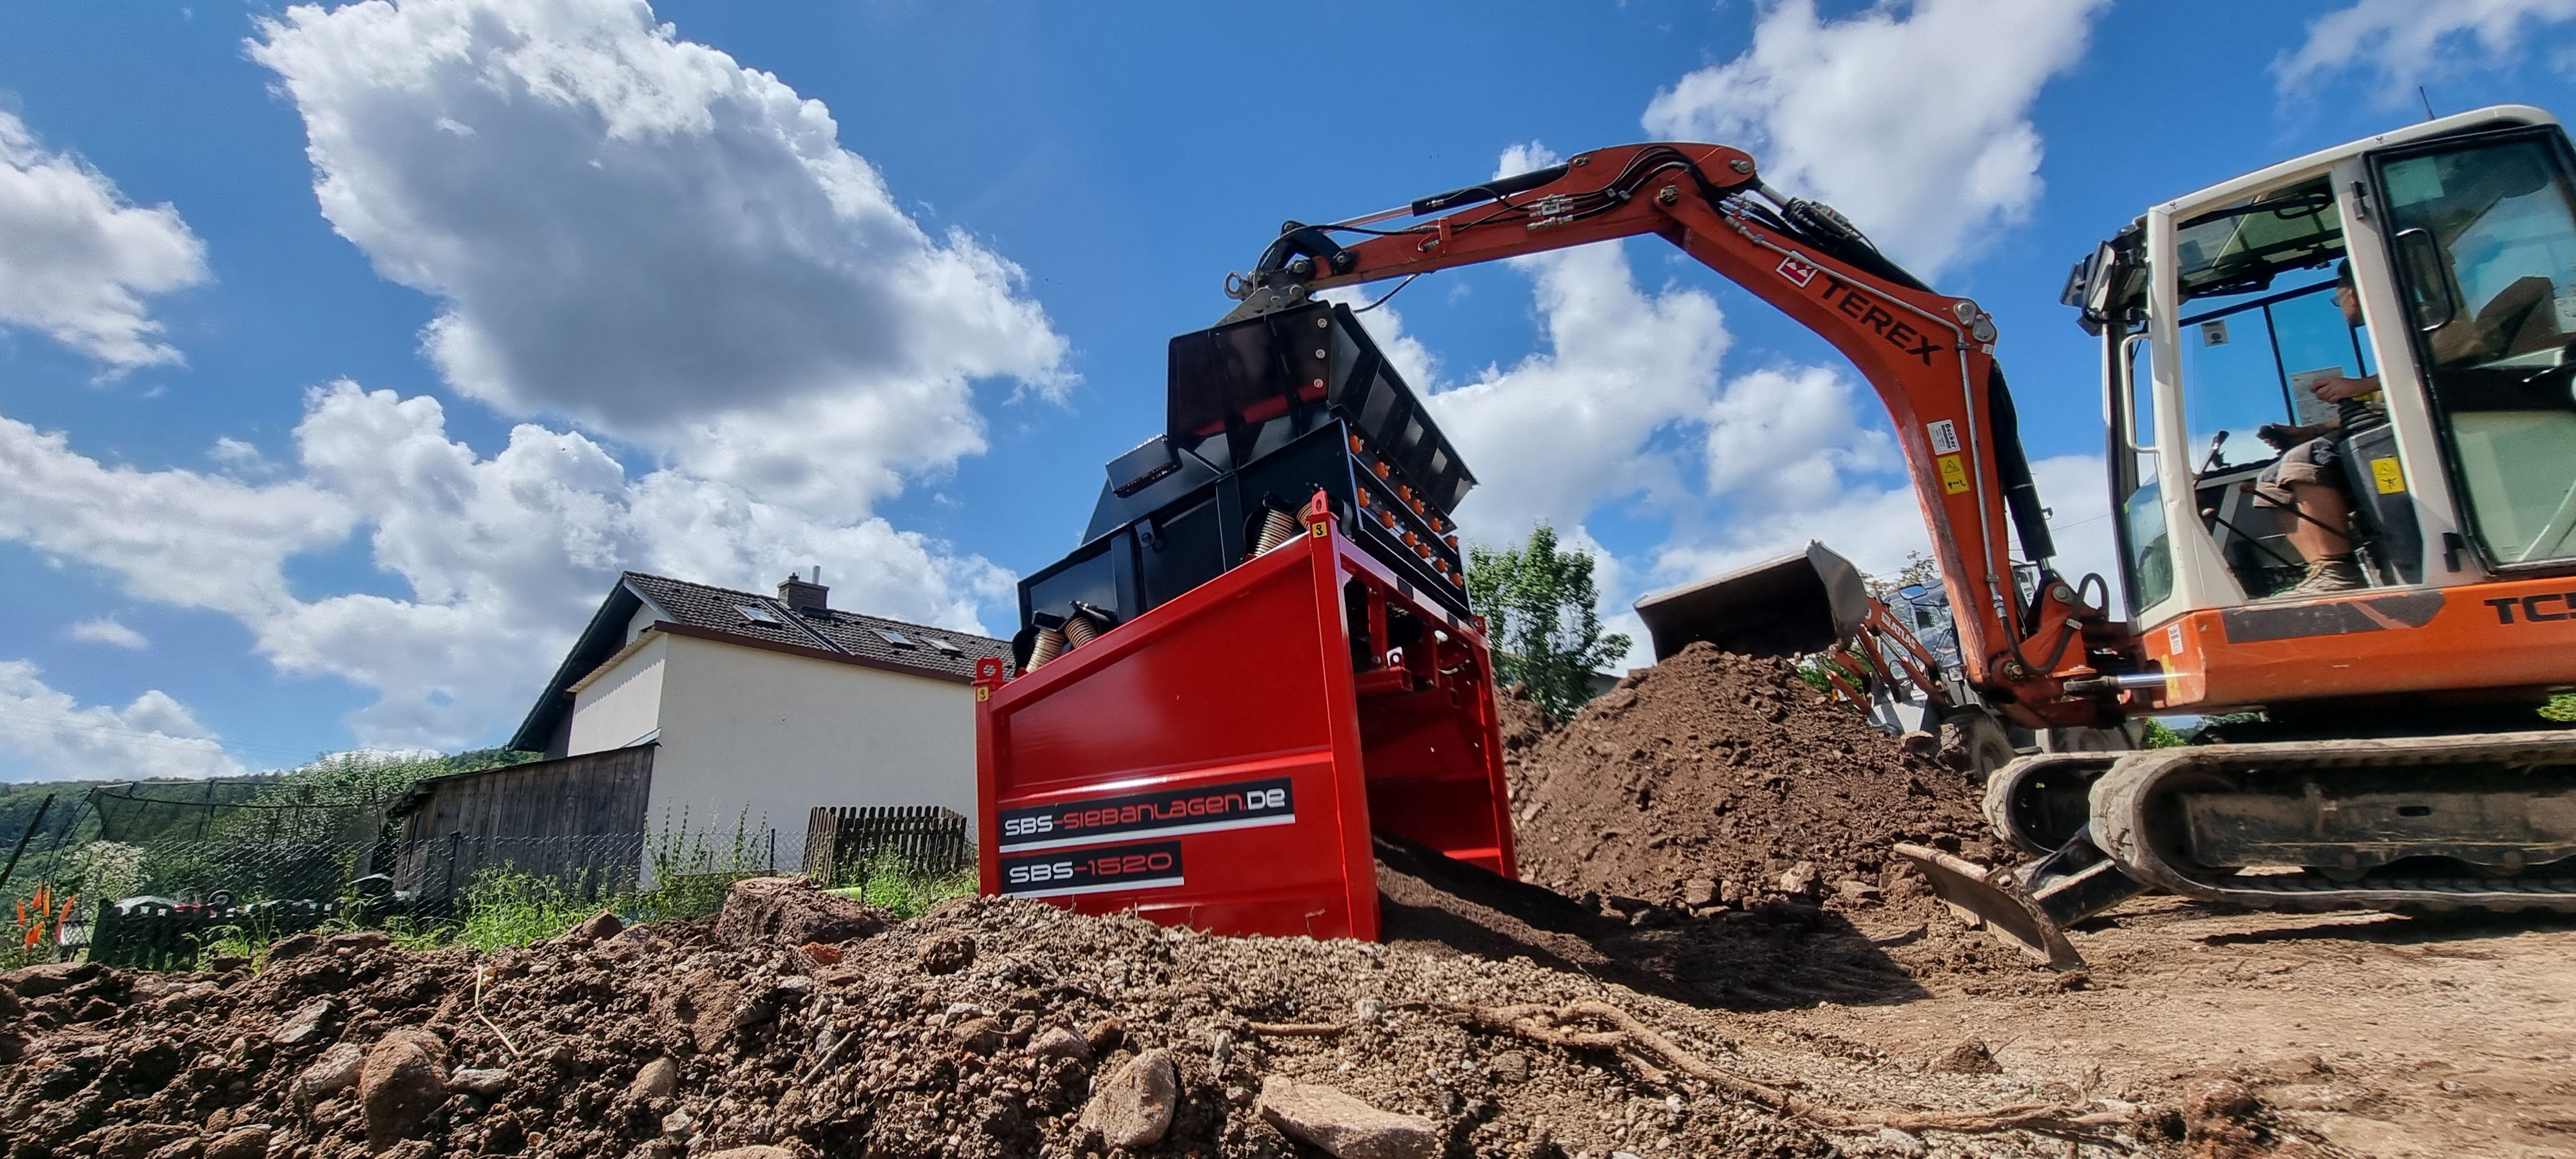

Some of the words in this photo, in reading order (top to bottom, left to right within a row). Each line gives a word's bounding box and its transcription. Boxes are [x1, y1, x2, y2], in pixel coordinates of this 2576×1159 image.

[1821, 274, 1944, 367] TEREX
[1891, 621, 1917, 650] ATLAS
[1009, 851, 1172, 884] SBS-1520
